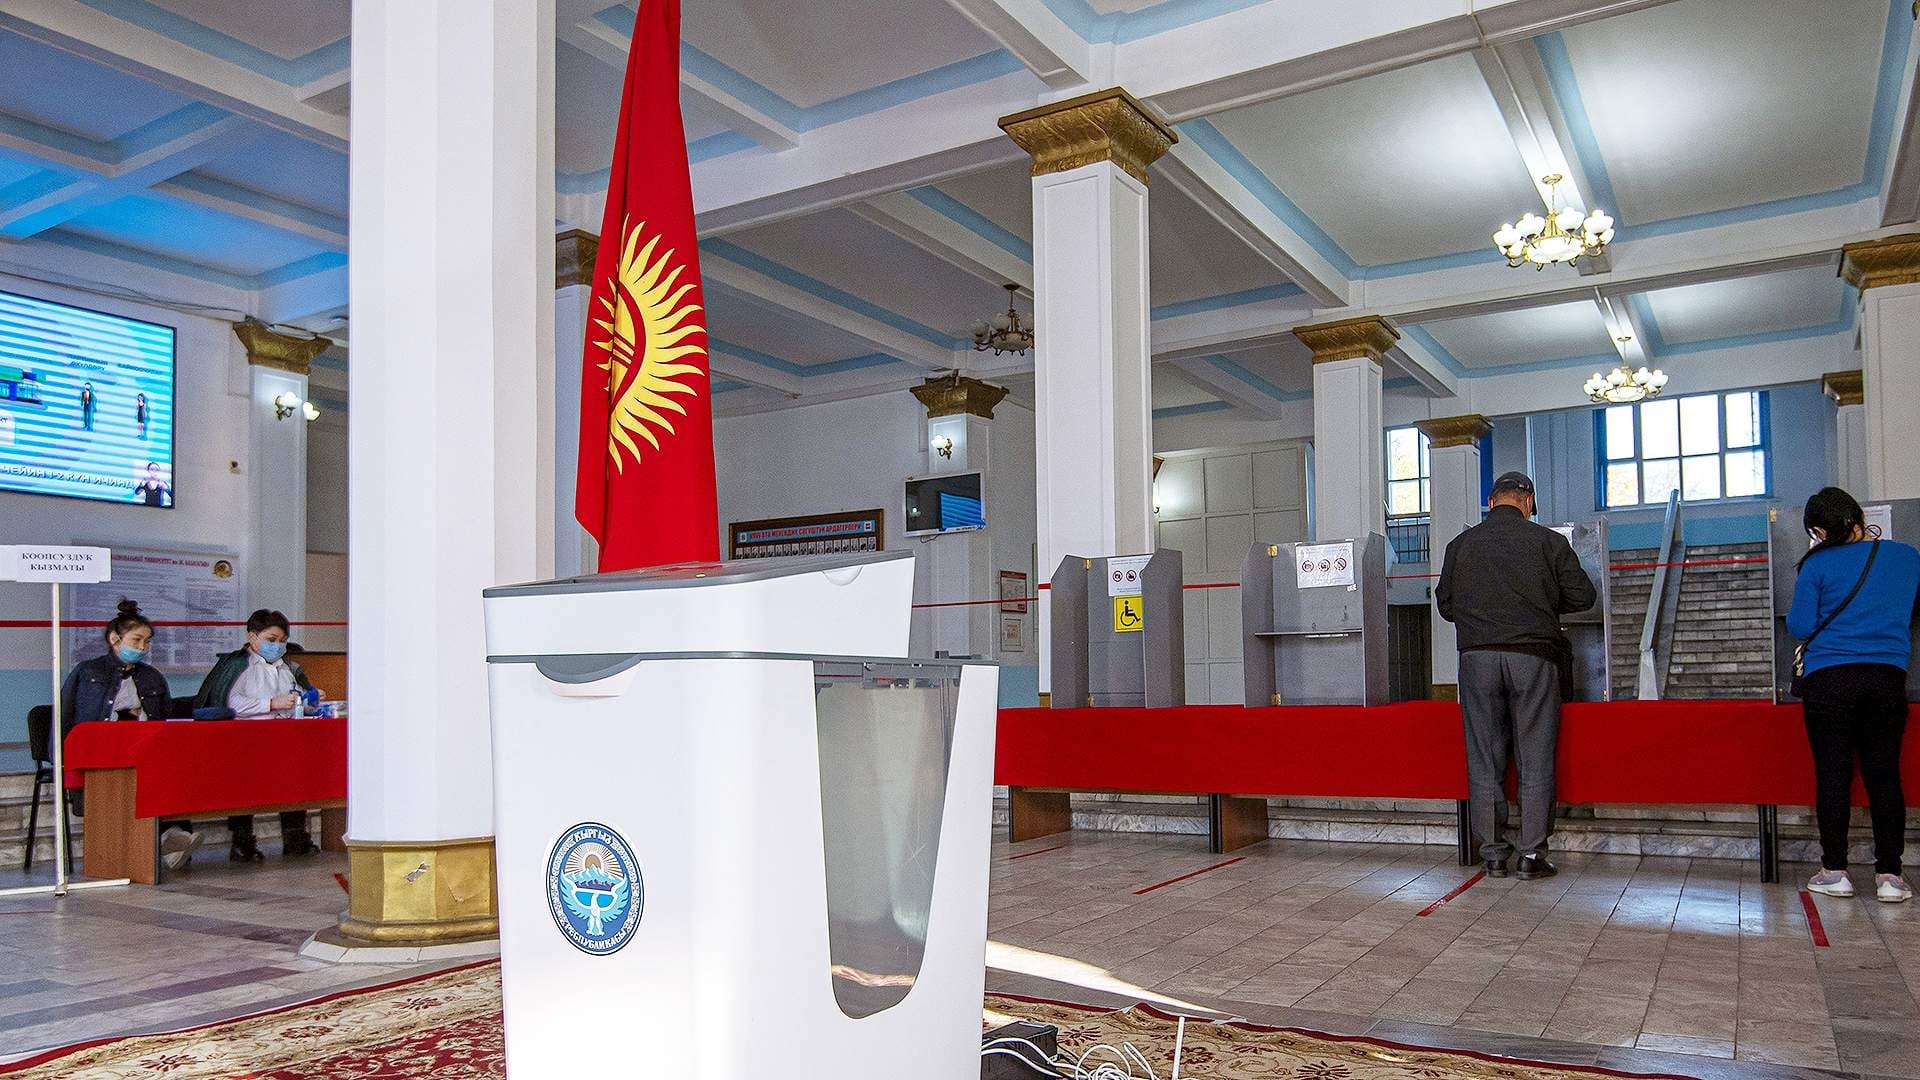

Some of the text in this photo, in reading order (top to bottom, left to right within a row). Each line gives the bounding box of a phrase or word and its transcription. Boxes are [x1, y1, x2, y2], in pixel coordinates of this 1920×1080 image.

[22, 552, 93, 561] КООПСУЗДУК
[30, 563, 85, 572] КЫЗМАТЫ
[575, 829, 612, 844] КЫРГЫЗ
